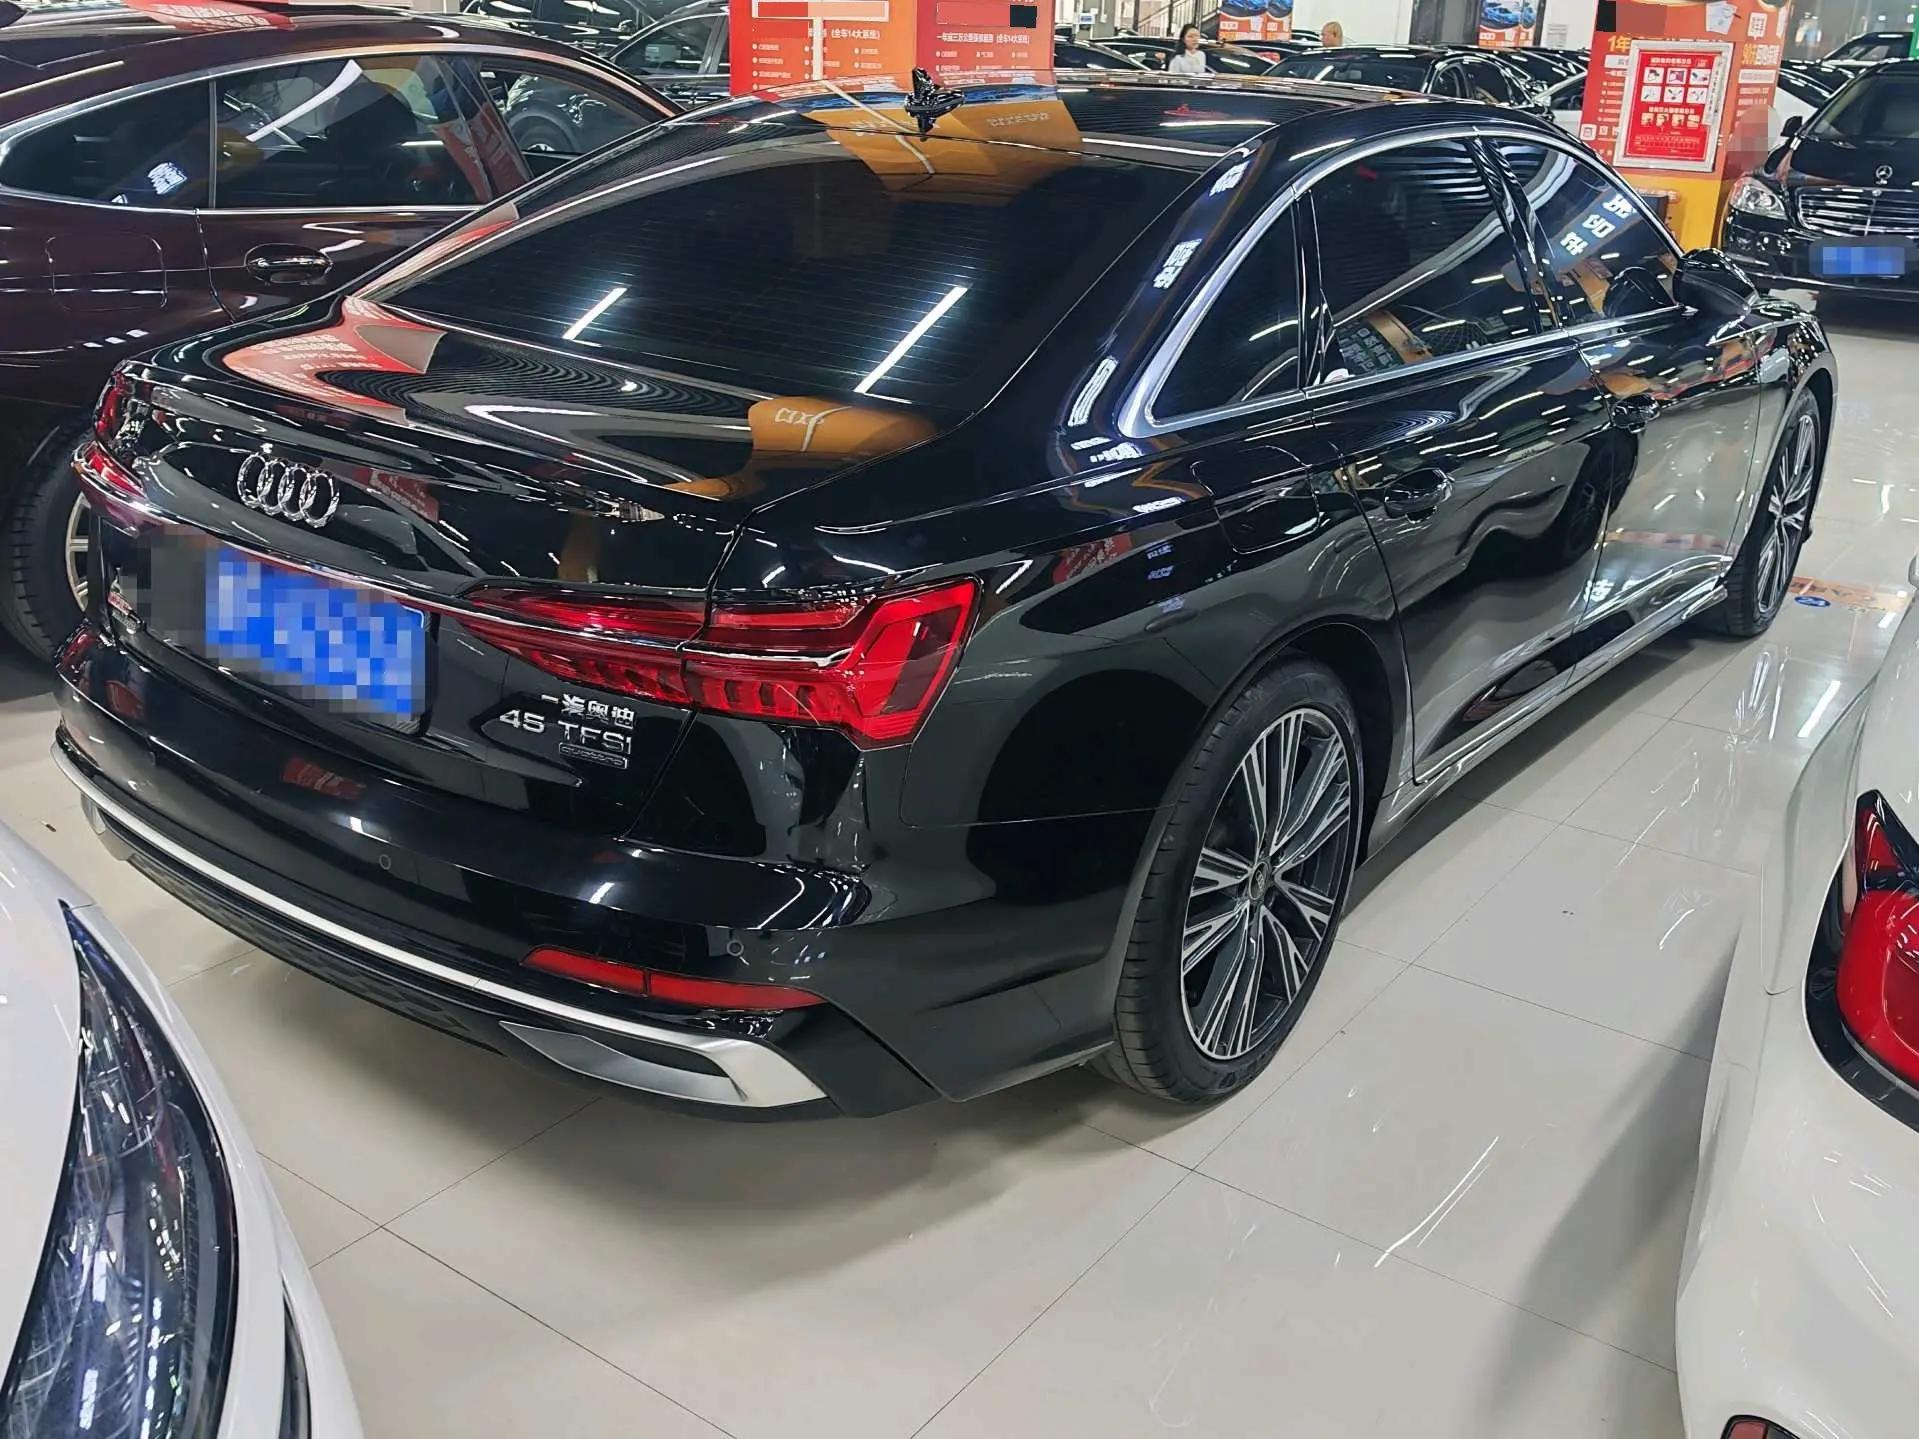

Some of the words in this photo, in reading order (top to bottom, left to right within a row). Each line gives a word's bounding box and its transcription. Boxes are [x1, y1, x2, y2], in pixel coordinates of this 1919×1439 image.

[499, 709, 545, 734] 45
[557, 720, 633, 755] TFSI
[541, 693, 635, 730] 一汽奥迪
